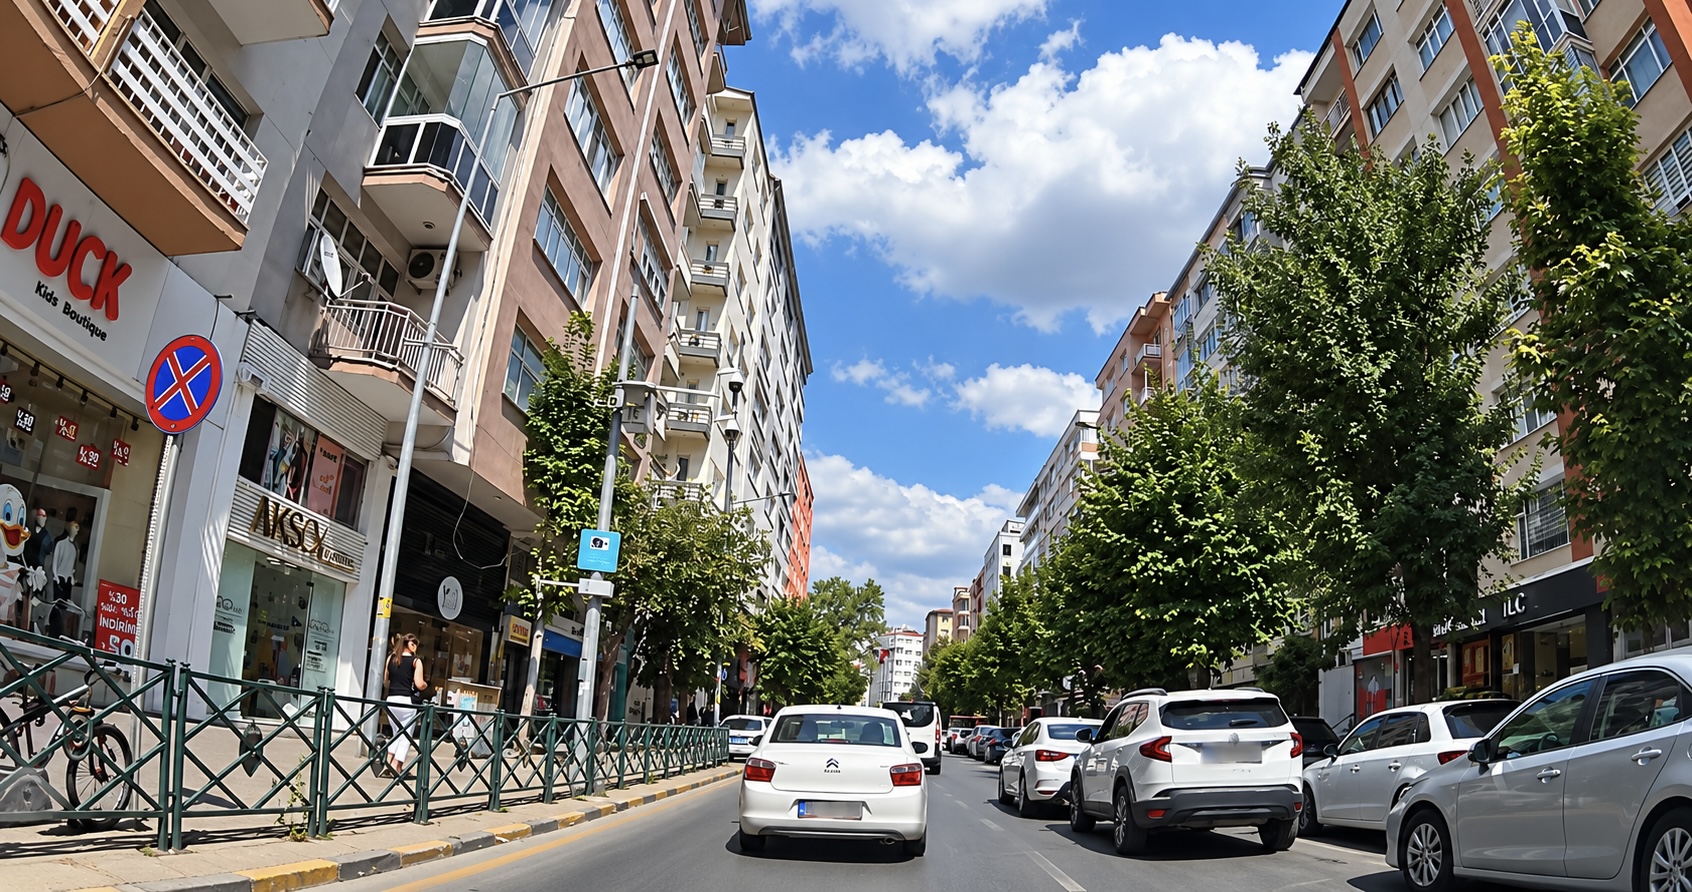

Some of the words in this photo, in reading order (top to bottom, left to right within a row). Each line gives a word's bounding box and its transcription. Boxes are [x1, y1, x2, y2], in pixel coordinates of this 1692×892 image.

[1, 177, 133, 321] DUCK
[34, 280, 60, 307] Kids
[62, 301, 108, 342] Boutique
[99, 613, 137, 635] İNDİRİM
